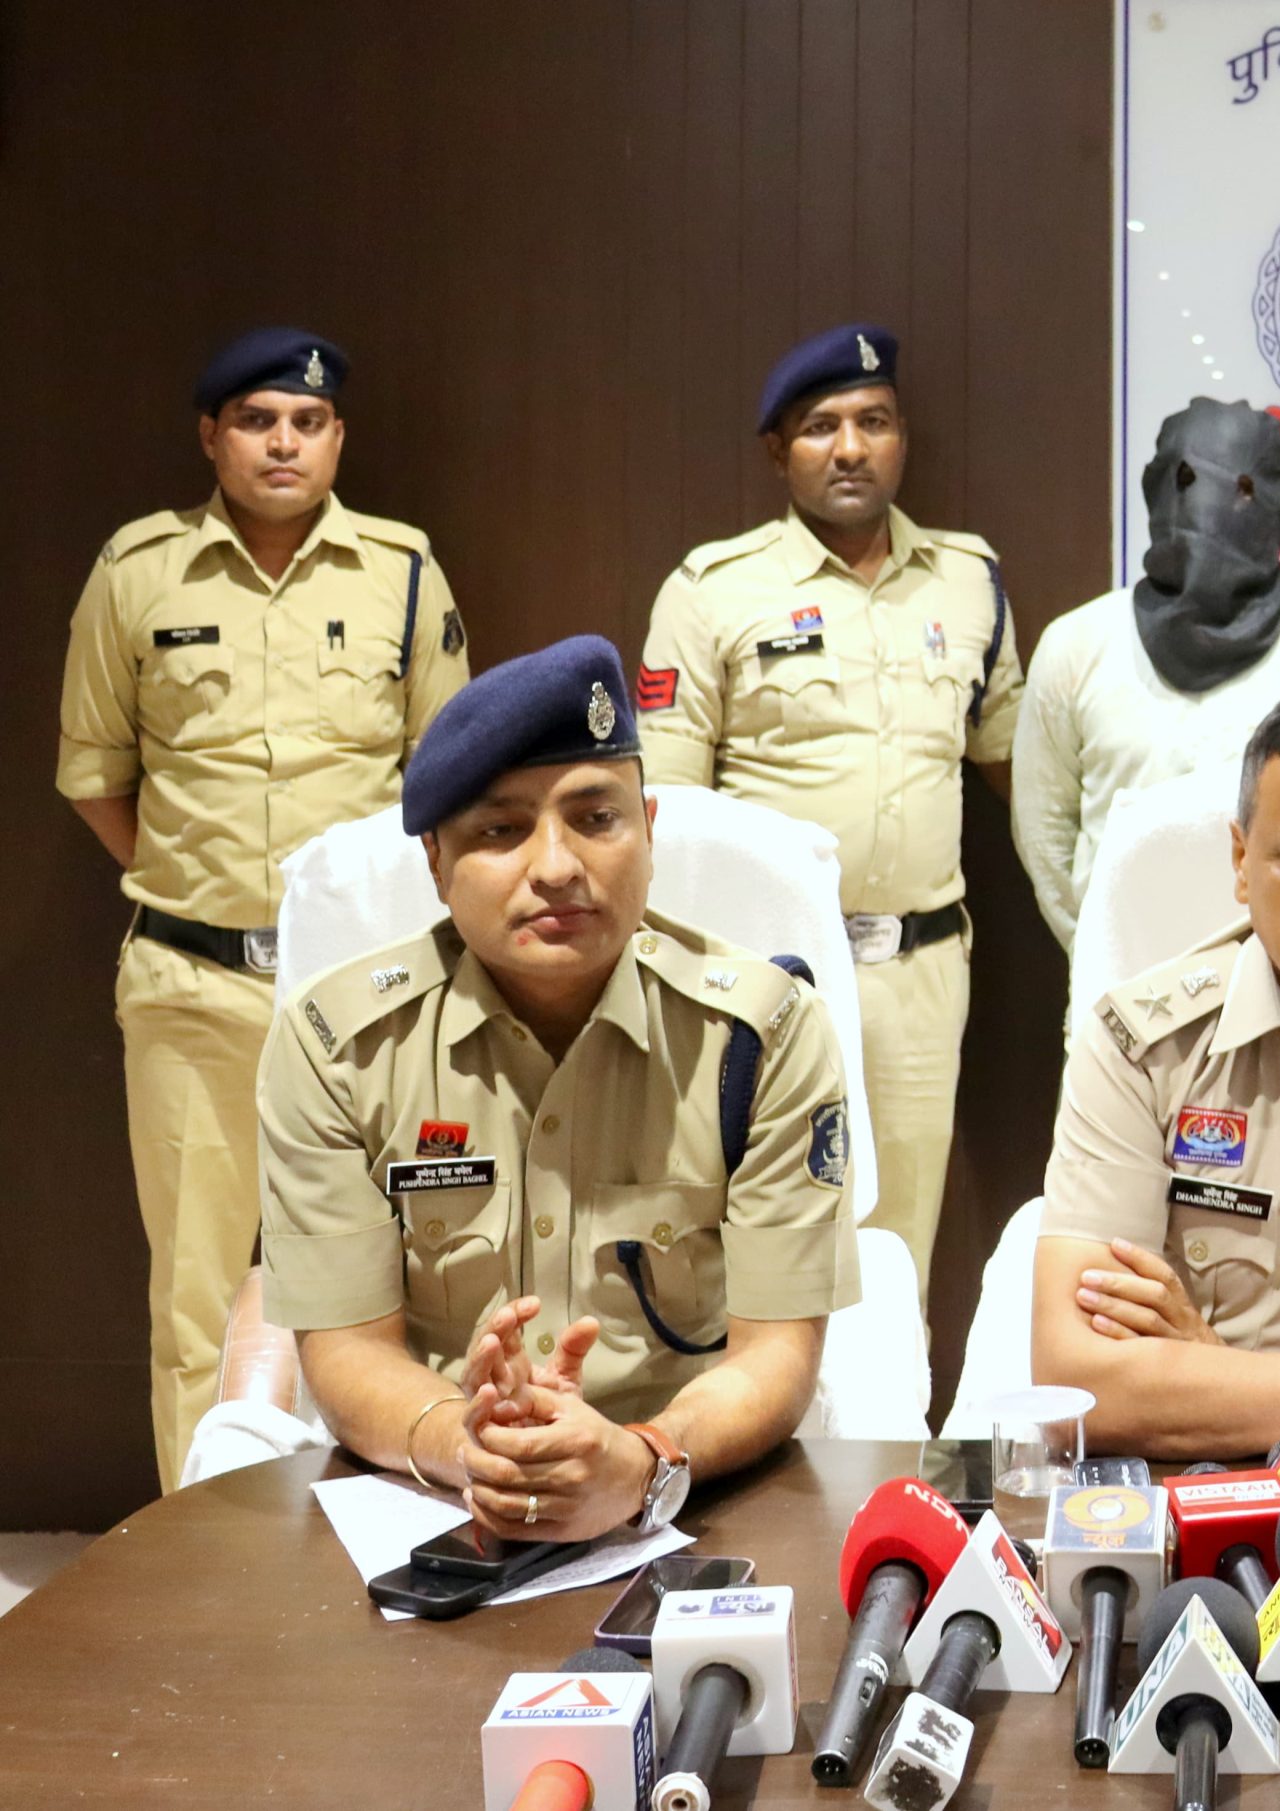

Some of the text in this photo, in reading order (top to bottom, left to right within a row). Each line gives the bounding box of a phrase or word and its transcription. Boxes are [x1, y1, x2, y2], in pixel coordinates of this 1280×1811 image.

[398, 1178, 440, 1189] PUSHPENDRA
[441, 1176, 462, 1186] SINGH
[1175, 1191, 1263, 1216] DHARMENDRA SINGH
[1181, 1483, 1274, 1498] VISTAAR
[994, 1556, 1050, 1651] BANSAL
[508, 1707, 610, 1718] ASIAN NEWS
